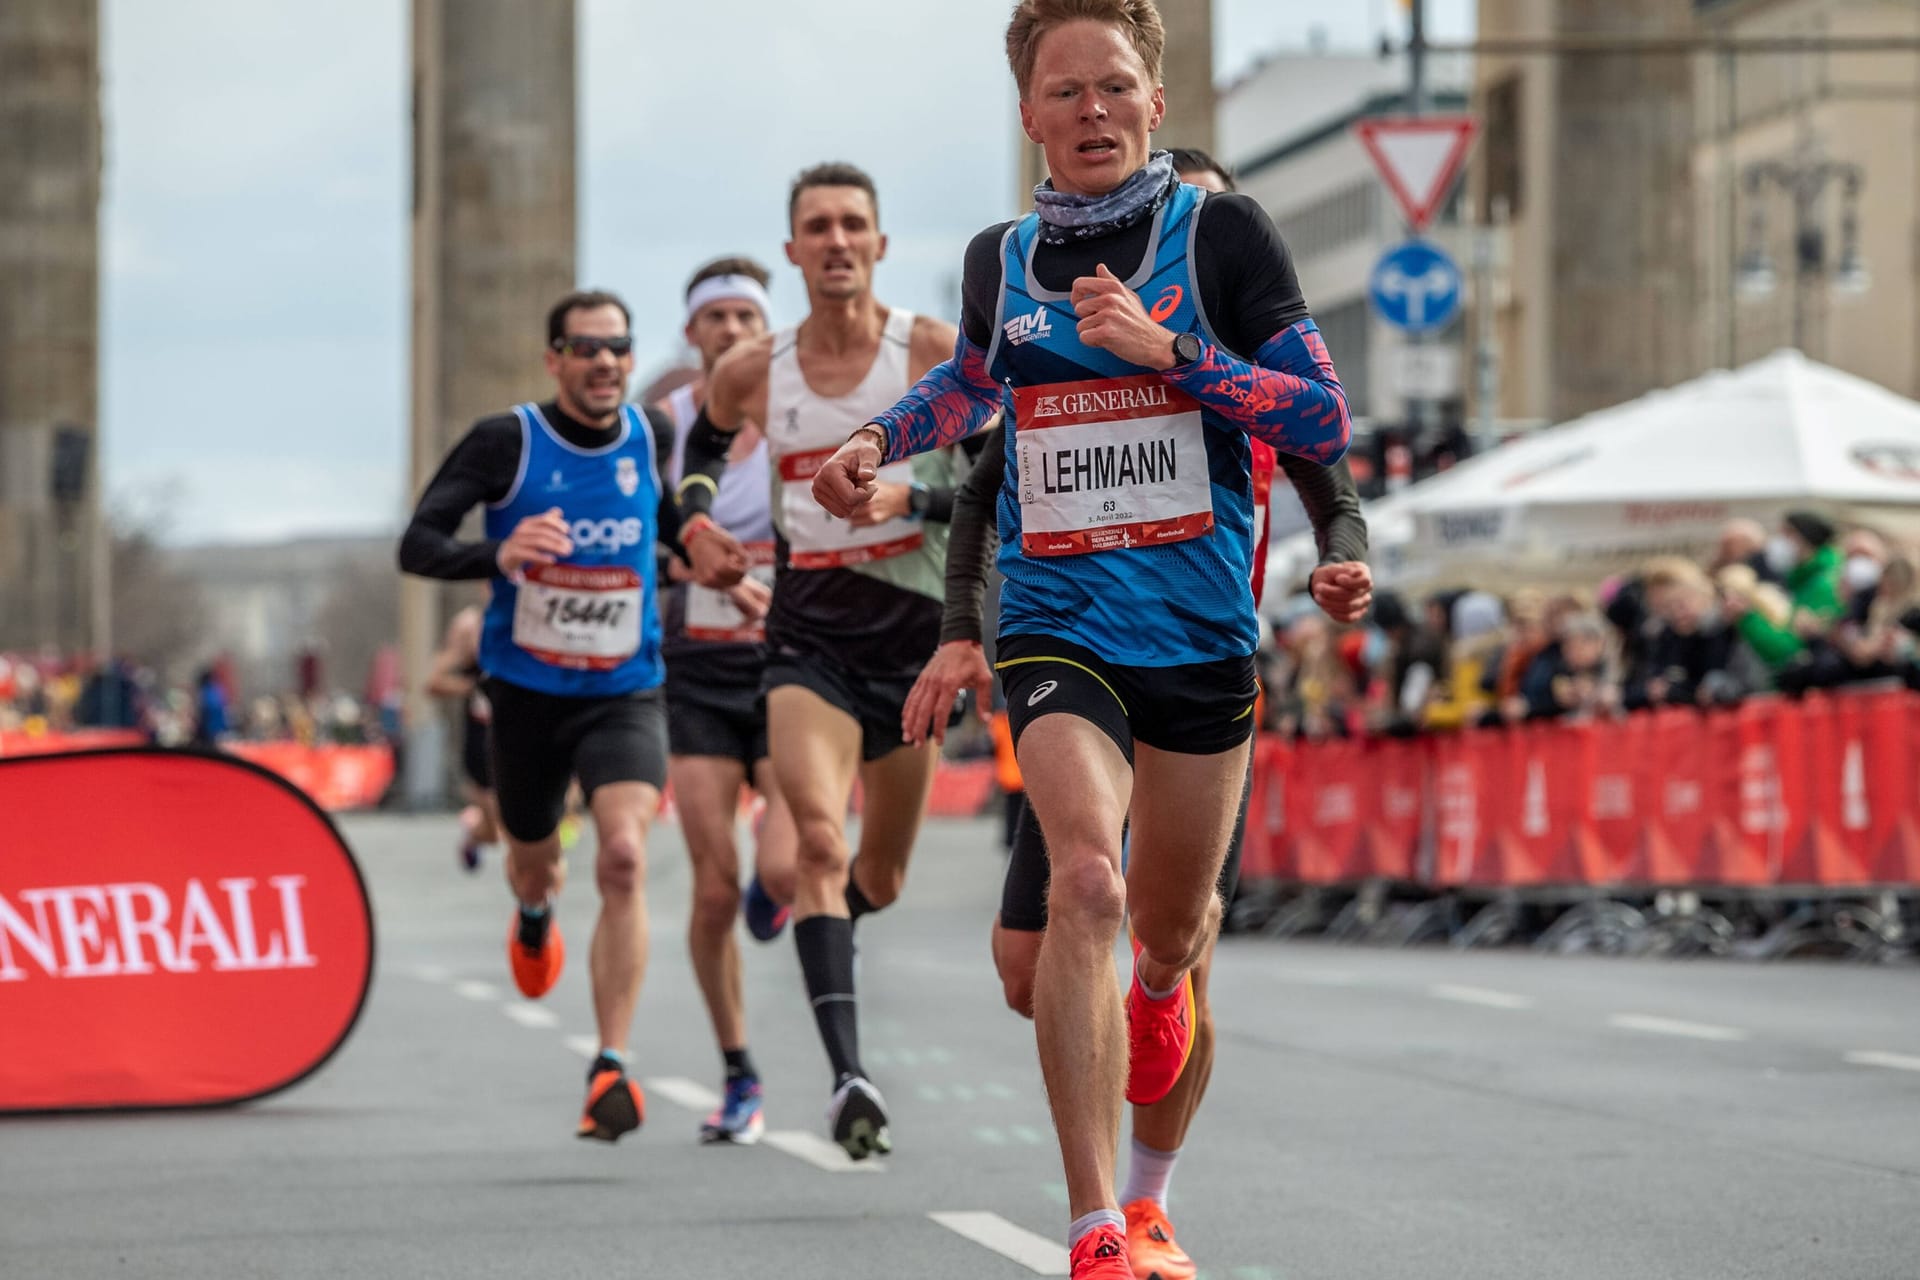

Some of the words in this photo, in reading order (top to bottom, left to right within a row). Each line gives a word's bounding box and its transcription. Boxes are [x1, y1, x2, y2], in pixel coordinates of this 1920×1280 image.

[1062, 384, 1169, 415] GENERALI
[1042, 438, 1176, 495] LEHMANN
[1096, 512, 1114, 521] April
[1115, 512, 1133, 520] 2022
[1103, 500, 1116, 512] 63
